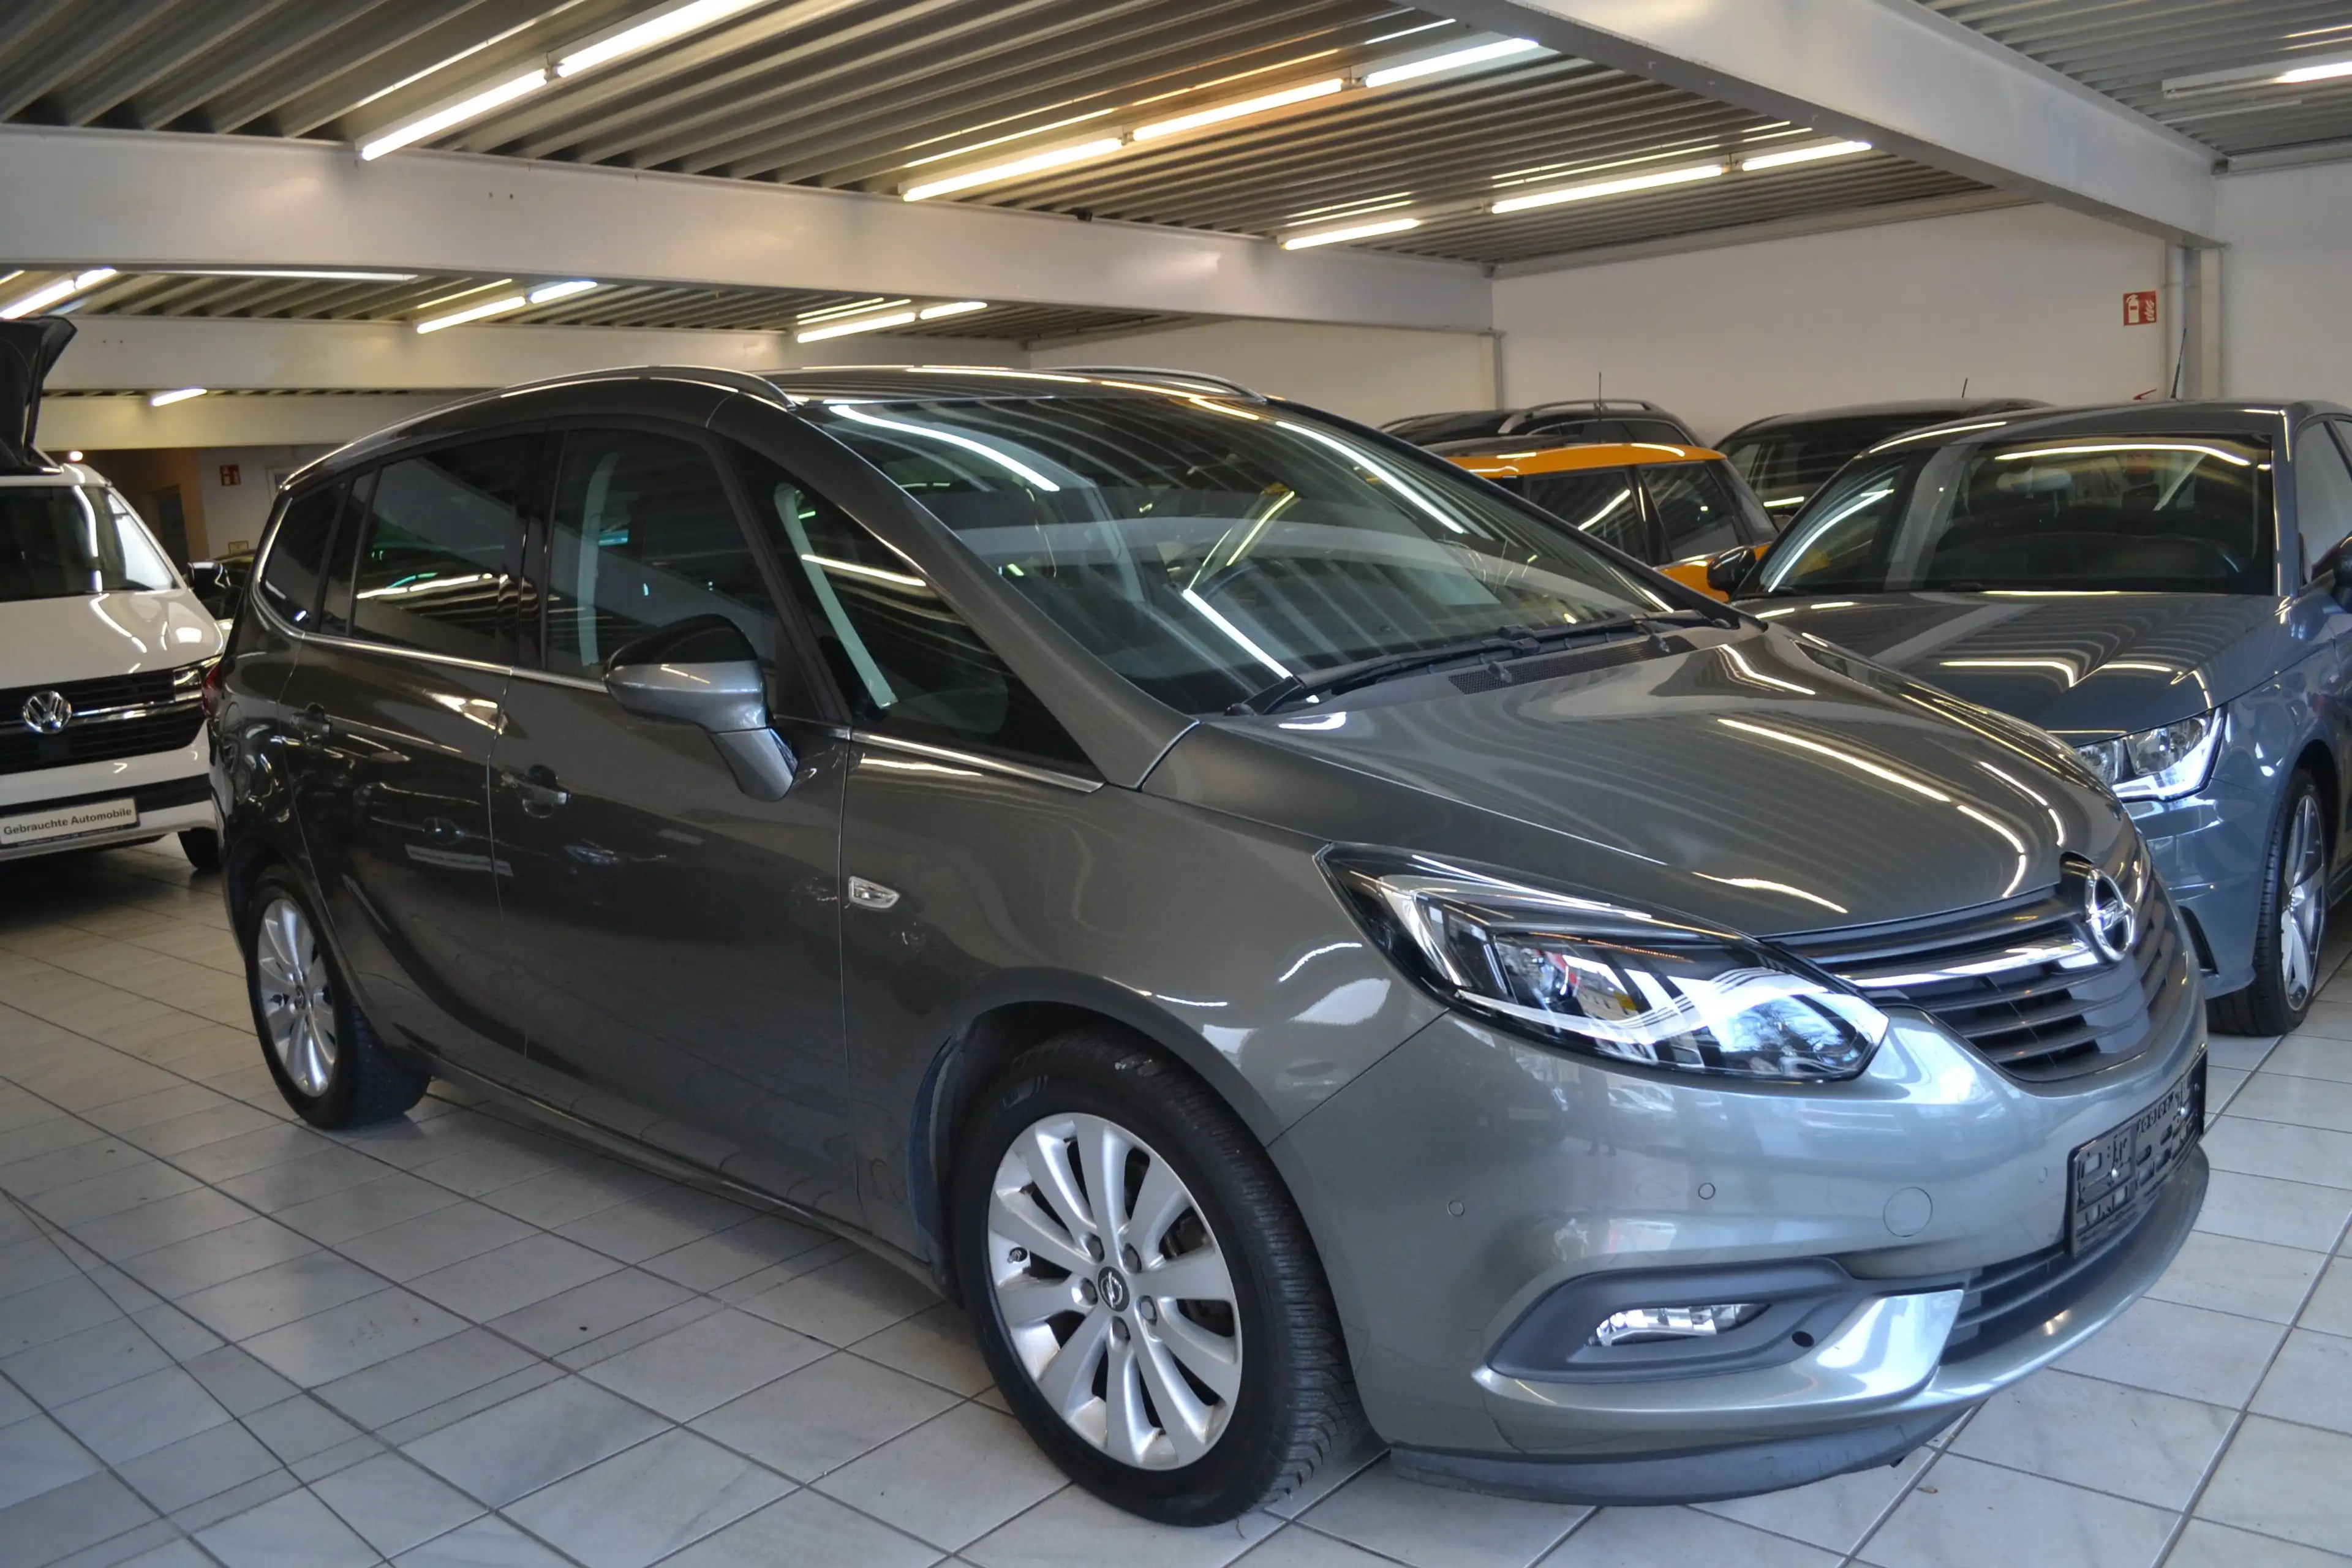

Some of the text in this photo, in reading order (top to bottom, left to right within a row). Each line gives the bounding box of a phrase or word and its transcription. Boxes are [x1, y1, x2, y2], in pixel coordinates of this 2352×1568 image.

[23, 691, 72, 734] VW
[4, 808, 132, 835] Gebrauchte Automobile
